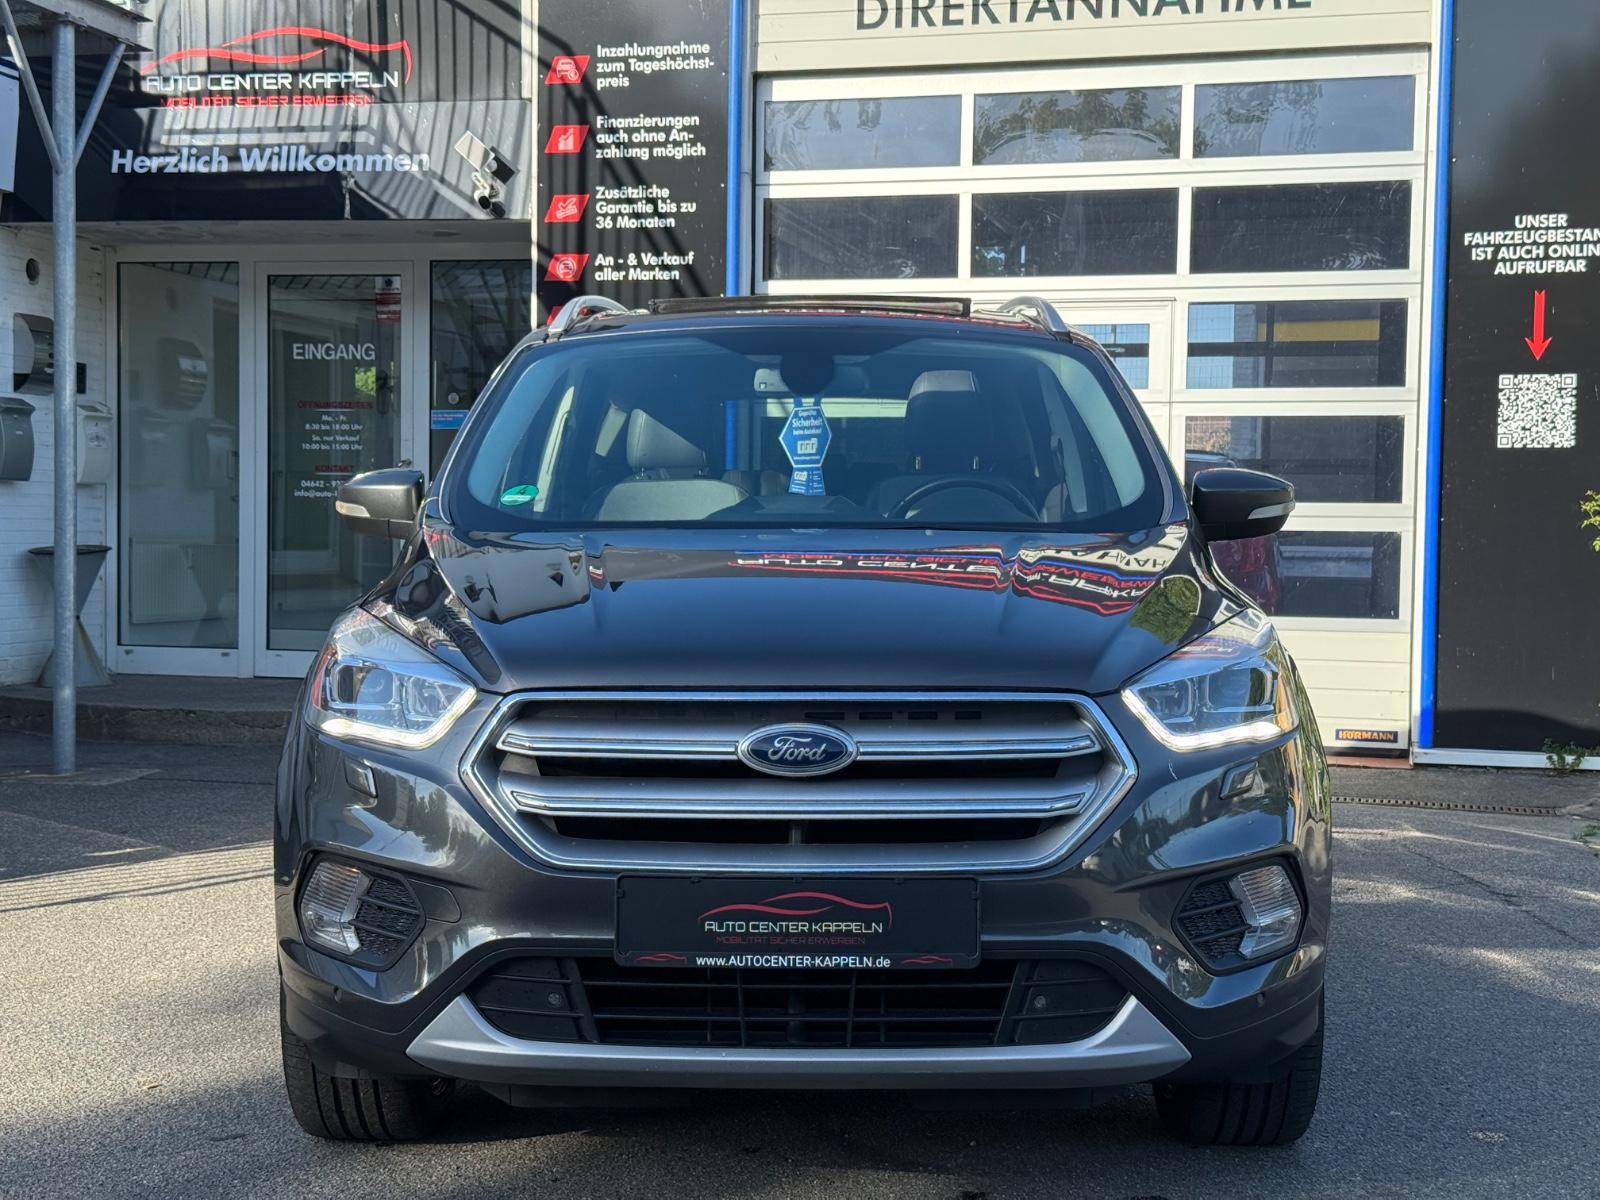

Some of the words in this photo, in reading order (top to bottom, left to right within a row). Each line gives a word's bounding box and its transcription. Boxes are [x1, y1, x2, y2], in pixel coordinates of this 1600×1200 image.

[597, 41, 710, 59] Inzahlungnahme
[597, 61, 625, 73] zum
[628, 56, 714, 74] Tageshöchst-
[147, 75, 200, 91] AUTO
[207, 73, 292, 90] CENTER
[298, 71, 398, 89] KAPPELN
[597, 74, 629, 91] preis
[236, 95, 290, 107] SICHER
[597, 114, 699, 129] Finanzierungen
[597, 131, 628, 144] auch
[632, 129, 666, 142] ohne
[669, 129, 695, 141] An-
[111, 148, 228, 173] Herzlich
[239, 145, 430, 172] Willkommen
[596, 144, 649, 160] zahlung
[653, 142, 706, 159] möglich
[595, 184, 670, 200] Zusätzliche
[596, 200, 654, 215] Garantie
[657, 200, 677, 213] bis
[680, 202, 697, 213] zu
[595, 217, 613, 229] 36
[616, 215, 676, 229] Monaten
[1514, 213, 1568, 229] UNSER
[594, 253, 614, 266] An
[627, 253, 638, 266] &
[641, 251, 694, 266] Verkauf
[1471, 246, 1495, 261] IST
[1497, 245, 1545, 260] AUCH
[594, 267, 625, 281] aller
[628, 267, 680, 280] Marken
[1493, 259, 1587, 275] AUFRUFBAR
[292, 343, 376, 360] EINGANG
[768, 736, 827, 761] Ford
[704, 921, 746, 932] AUTO
[749, 921, 808, 933] CENTER
[812, 921, 883, 933] KAPPELN
[769, 936, 806, 945] SICHER
[695, 955, 891, 968] www.AUTOCENTER-KAPPELN.de
